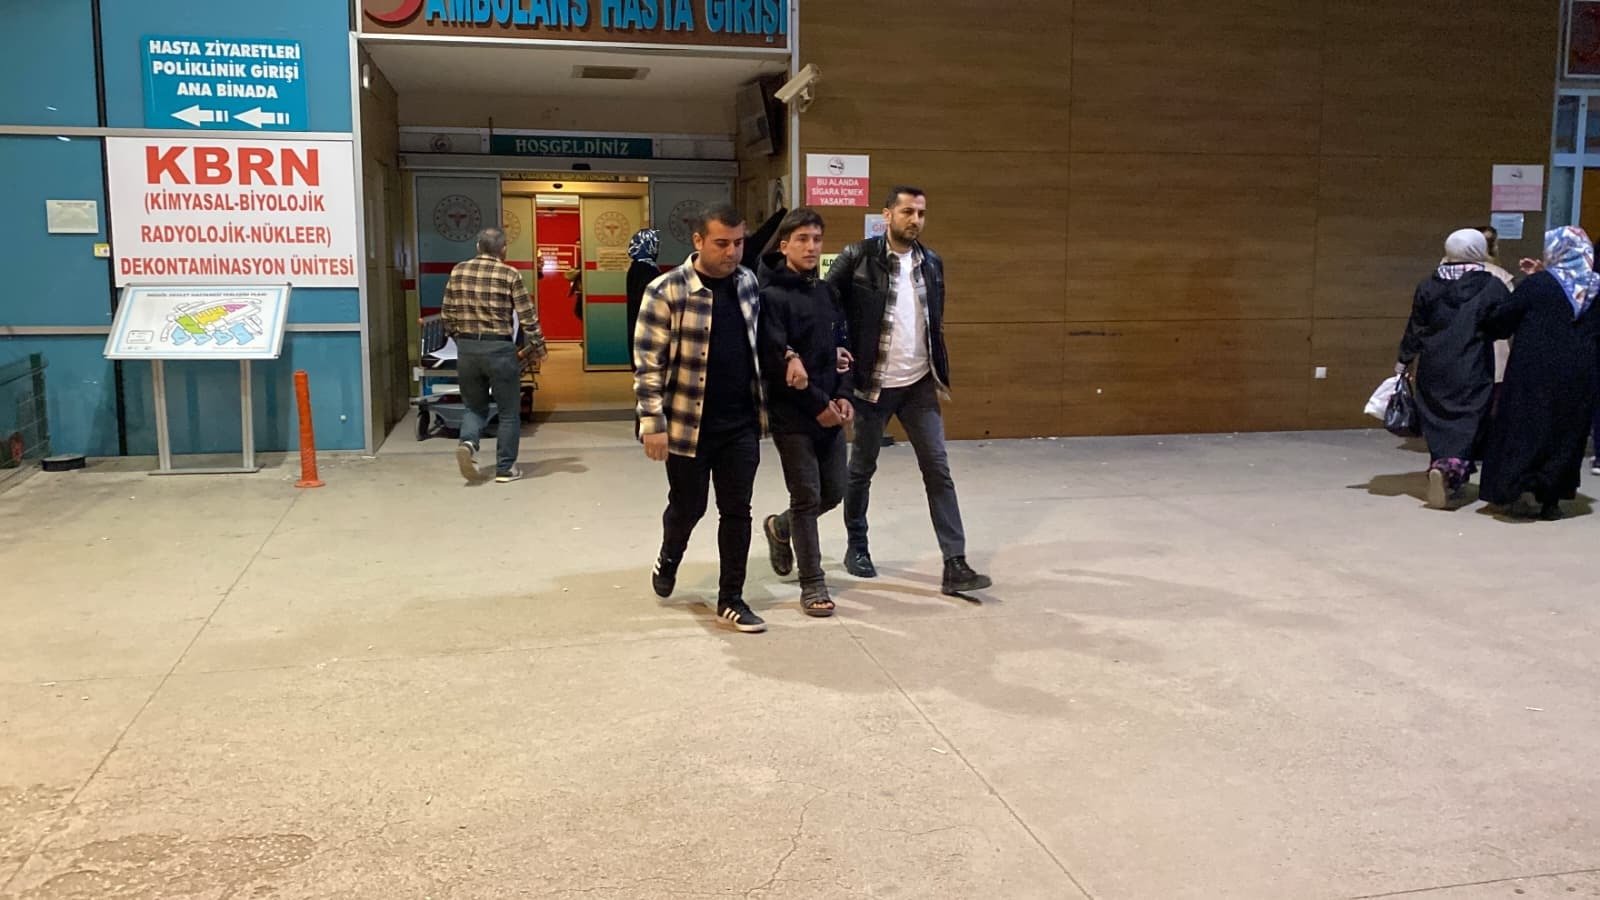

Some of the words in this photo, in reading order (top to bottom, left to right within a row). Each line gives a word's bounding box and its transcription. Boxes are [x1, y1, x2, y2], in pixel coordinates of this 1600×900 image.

[149, 40, 201, 56] HASTA
[205, 40, 301, 59] ZİYARETLERİ
[152, 58, 247, 77] POLİKLİNİK
[251, 61, 299, 83] GİRİŞİ
[176, 82, 212, 97] ANA
[216, 80, 278, 99] BİNADA
[145, 145, 321, 187] KBRN
[816, 178, 828, 186] BU
[829, 179, 859, 187] ALANDA
[144, 188, 325, 214] (KİMYASAL-BİYOLOJİK
[820, 197, 856, 206] YASAKTIR
[141, 221, 332, 247] RADYOLOJİK-NÜKLEER)
[120, 253, 285, 275] DEKONTAMİNASYON
[290, 253, 354, 275] ÜNİTESİ
